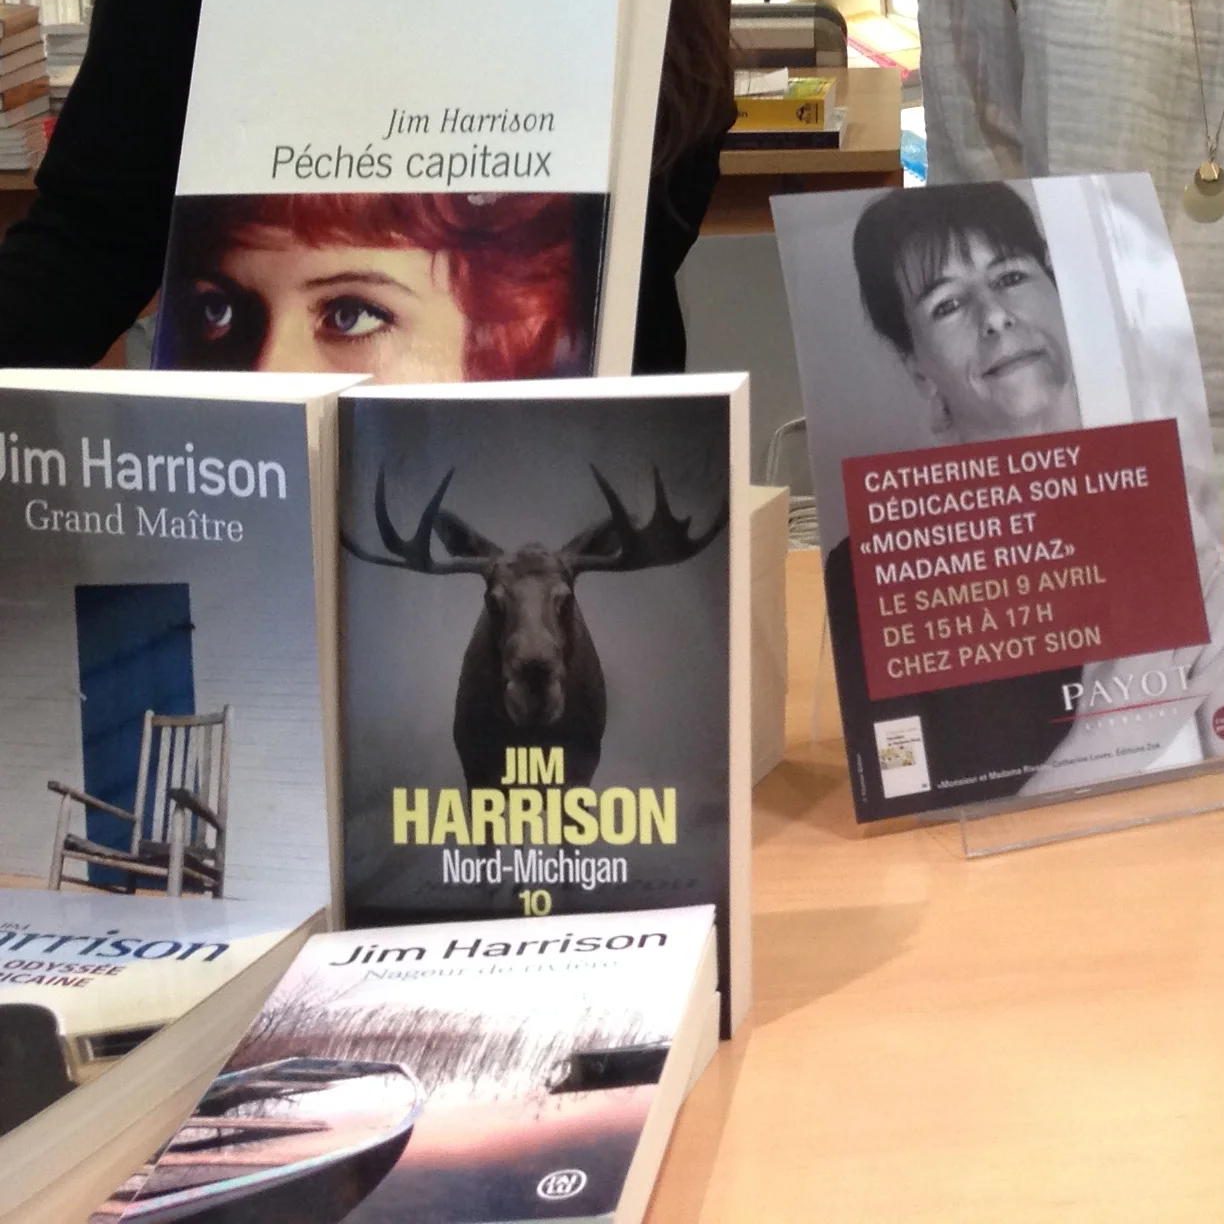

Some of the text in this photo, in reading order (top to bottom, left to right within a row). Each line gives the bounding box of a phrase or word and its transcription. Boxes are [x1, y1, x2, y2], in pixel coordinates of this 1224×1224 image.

[383, 107, 556, 141] Jim Harrison
[272, 143, 552, 186] Péchés capitaux
[81, 437, 287, 500] Harrison
[864, 445, 1081, 493] CATHERINE LOVEY
[868, 466, 1150, 524] DÉDICACERA SON LIVRE
[25, 499, 244, 543] Grand Maître
[860, 512, 1037, 556] «MONSIEUR ET
[875, 538, 1076, 585] MADAME RIVAZ»
[879, 565, 1107, 617] LE SAMEDI 9 AVRIL
[884, 625, 916, 648] DE
[980, 607, 998, 632] À
[887, 626, 1101, 678] CHEZ PAYOT SION
[1061, 664, 1191, 711] PAYOT
[501, 746, 564, 785] JIM
[393, 787, 677, 845] HARRISON
[442, 849, 628, 890] Nord-Michigan
[519, 889, 552, 917] 10
[329, 932, 669, 967] Jim Harrison
[363, 964, 471, 982] Nageur
[479, 965, 515, 977] de
